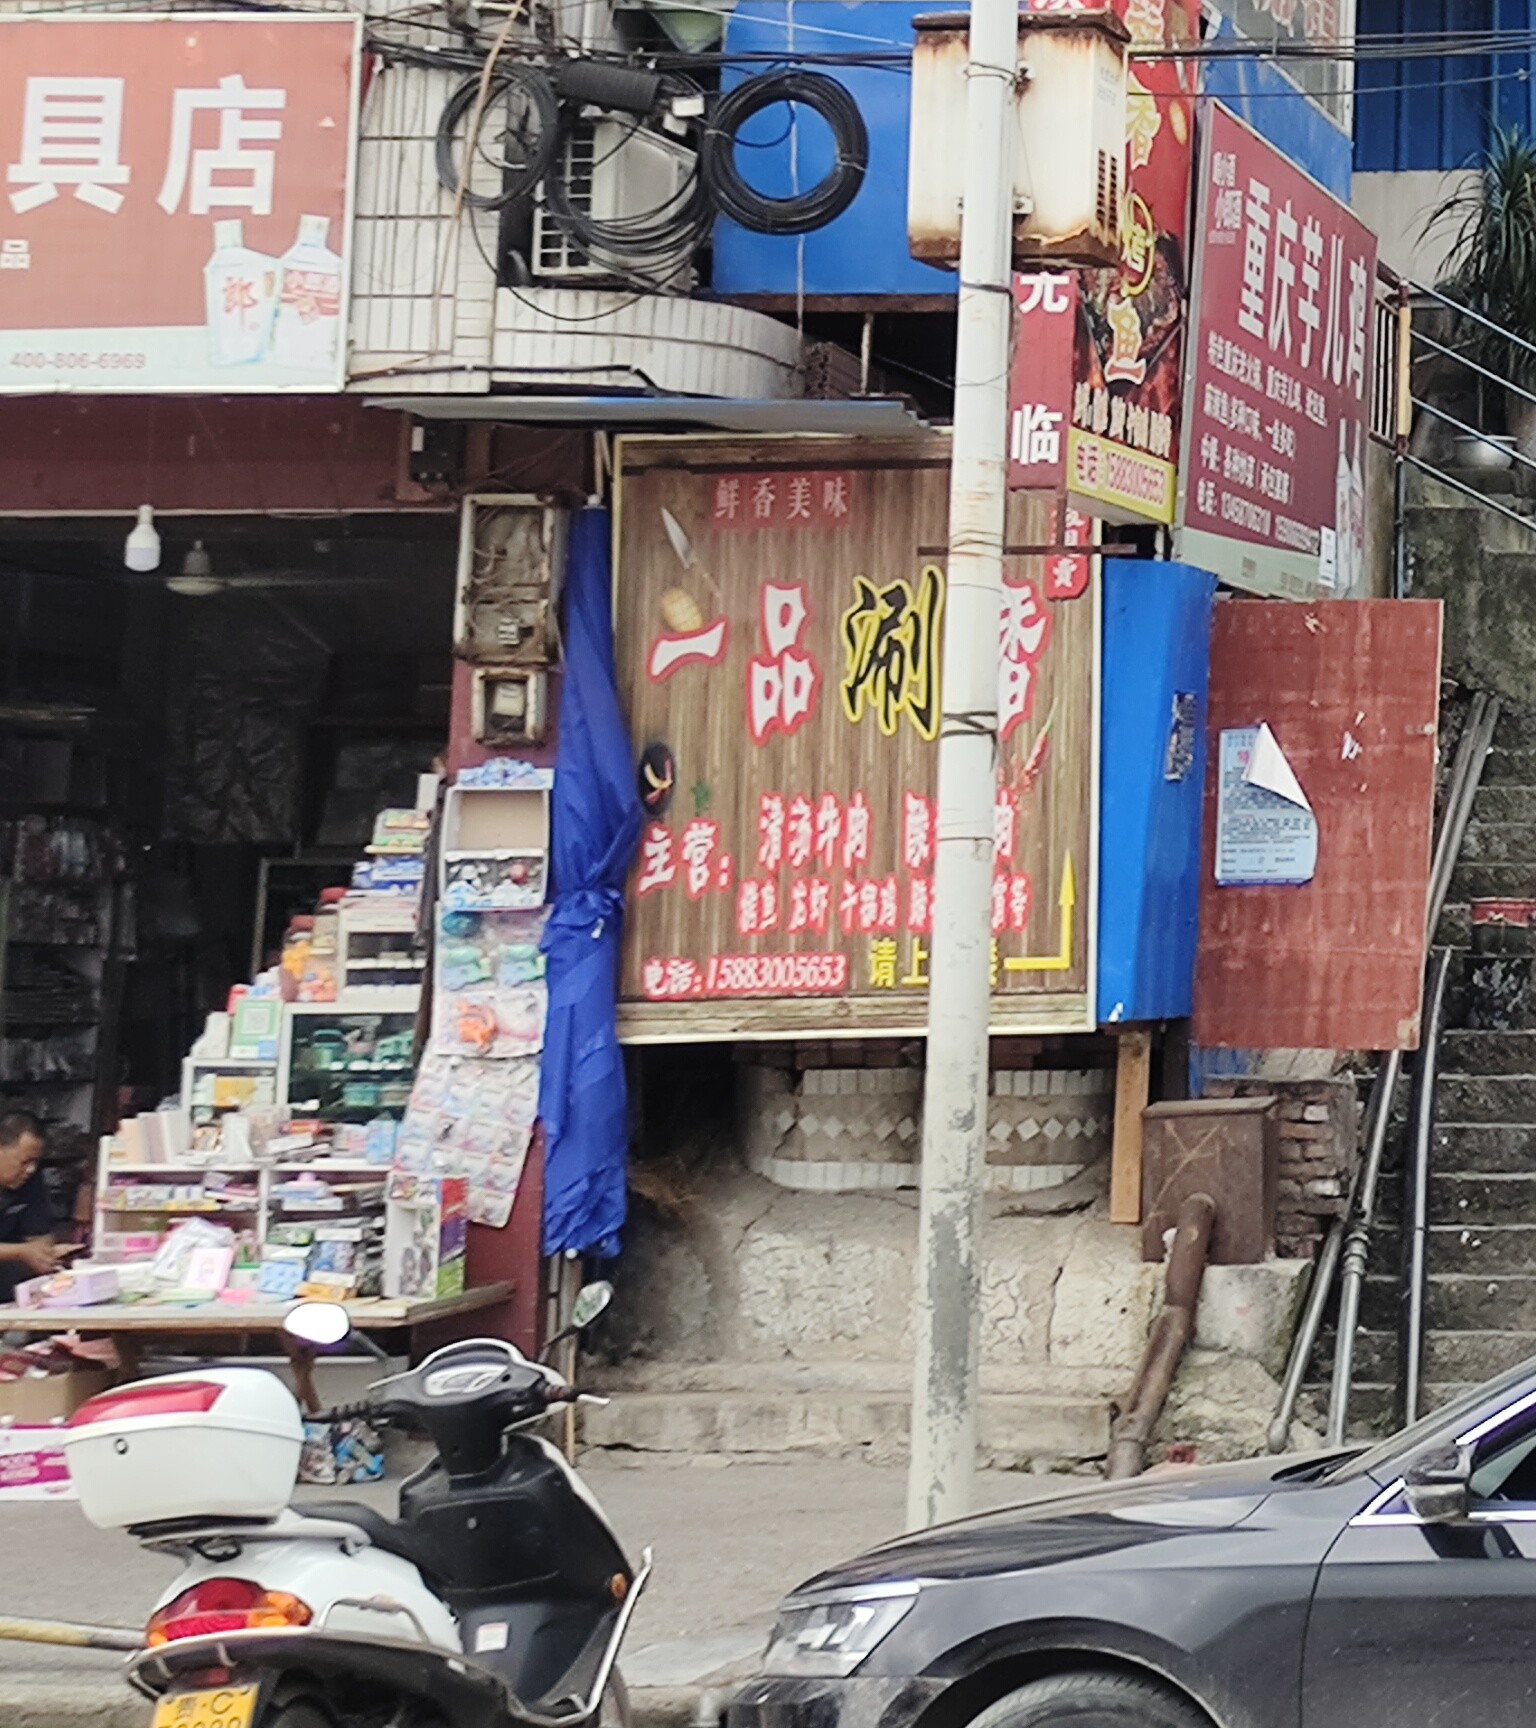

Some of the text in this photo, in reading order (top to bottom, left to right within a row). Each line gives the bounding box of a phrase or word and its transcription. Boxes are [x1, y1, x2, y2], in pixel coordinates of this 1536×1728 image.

[4, 73, 287, 217] 具店
[1239, 176, 1368, 402] 重庆芋儿鸡
[9, 352, 146, 370] 400-806-6969
[714, 478, 849, 520] 鲜香美味
